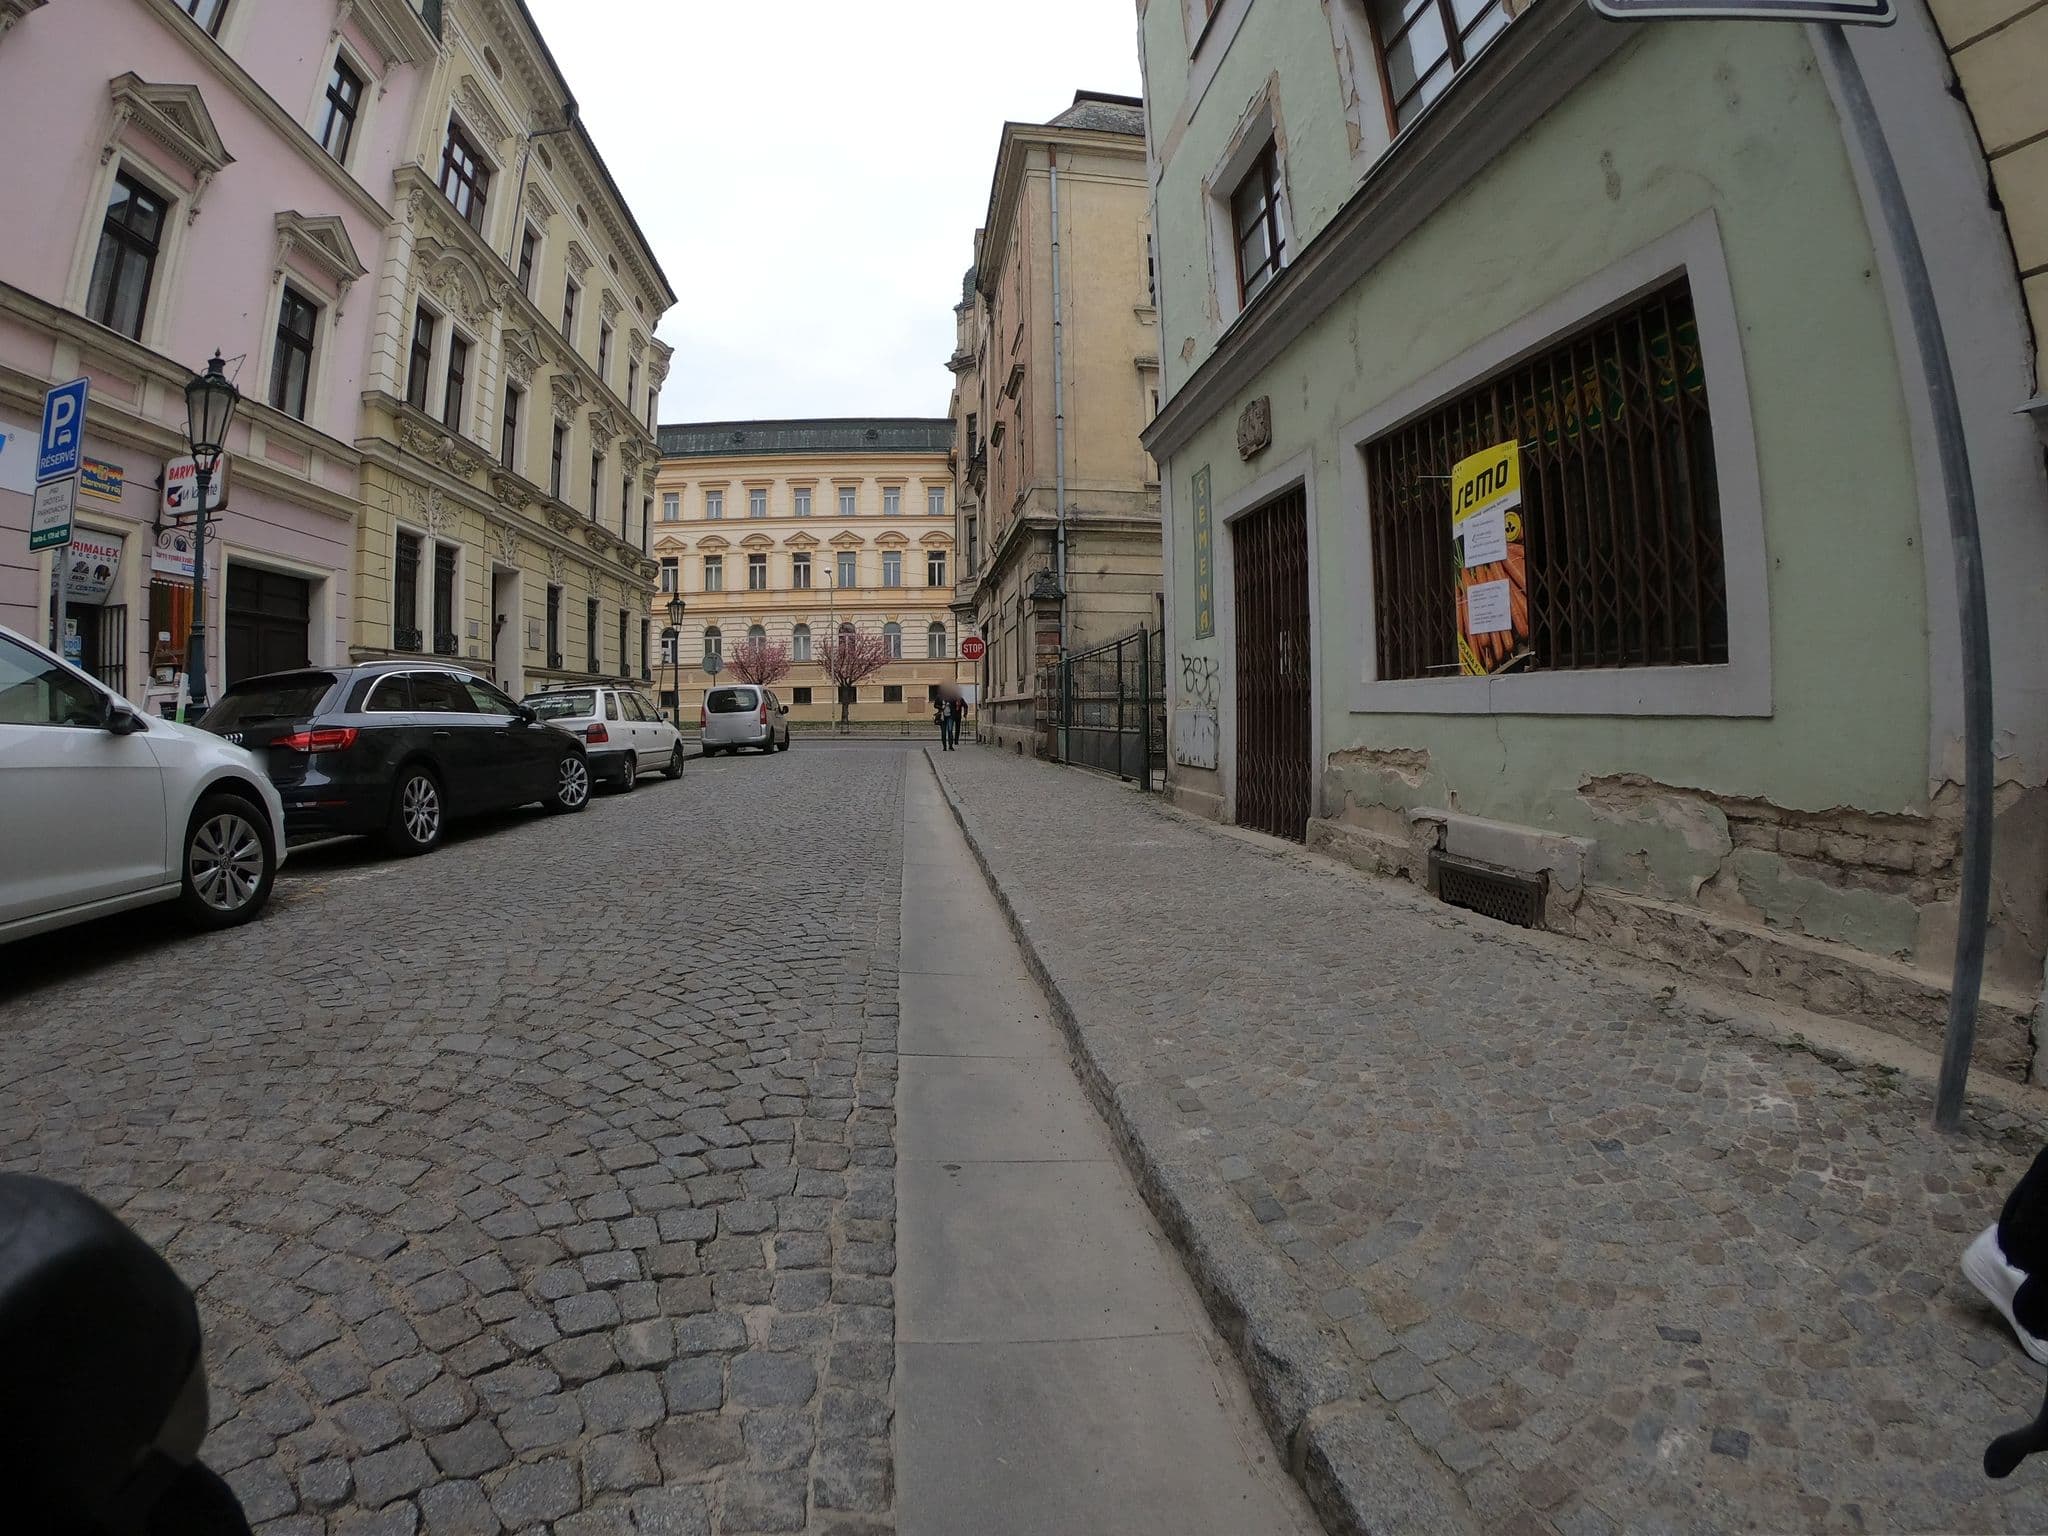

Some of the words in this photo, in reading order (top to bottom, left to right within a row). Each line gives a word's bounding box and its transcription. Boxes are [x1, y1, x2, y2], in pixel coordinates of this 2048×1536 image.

[47, 394, 76, 450] P
[168, 464, 195, 481] BARVY
[70, 541, 120, 558] RIMALEX
[1197, 477, 1211, 632] SEMENA
[963, 643, 983, 654] STOP
